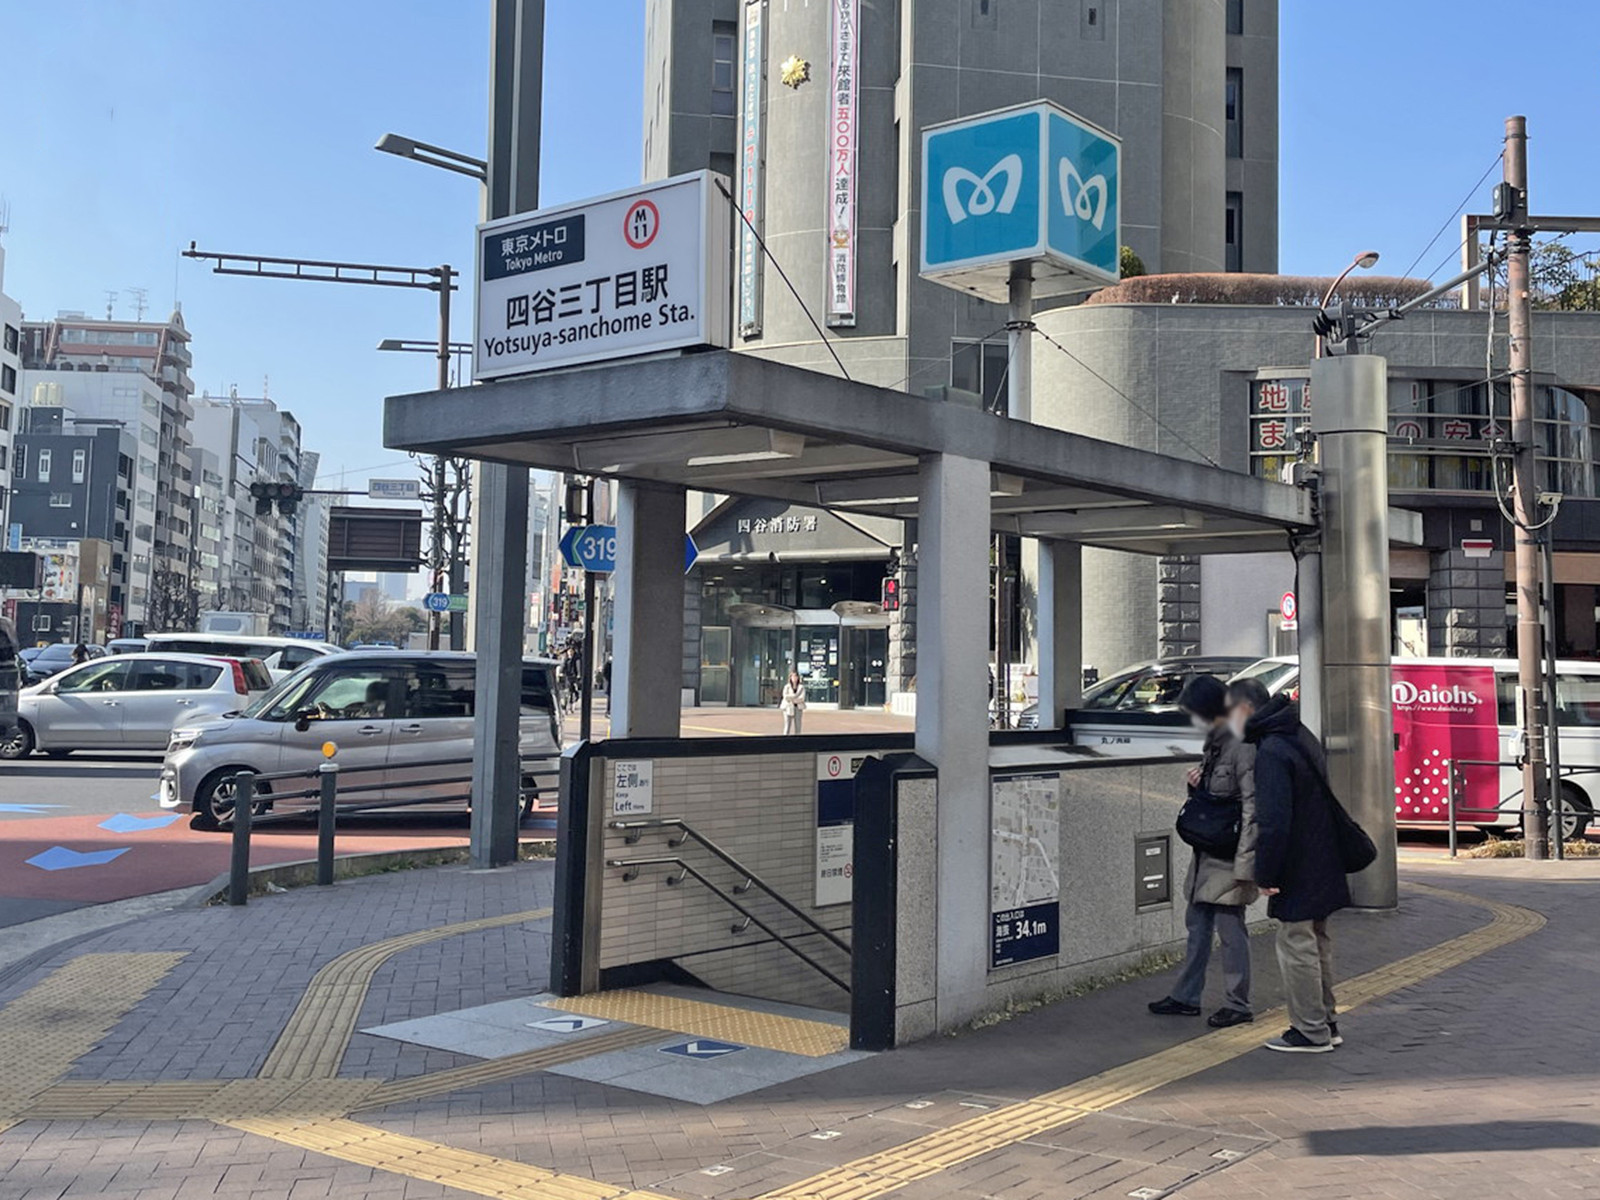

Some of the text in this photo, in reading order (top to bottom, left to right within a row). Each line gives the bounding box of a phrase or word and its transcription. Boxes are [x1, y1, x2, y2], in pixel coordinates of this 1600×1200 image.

[634, 208, 647, 222] M
[501, 225, 567, 257] 東京メトロ
[633, 223, 648, 240] 11
[504, 250, 563, 272] Tokyo Metro
[506, 263, 669, 331] 四谷三丁目駅
[484, 303, 695, 359] Yotsuya-sanchome Sta.
[737, 516, 819, 534] 四谷消防署
[583, 536, 616, 561] 319
[432, 596, 448, 608] 319
[615, 800, 632, 811] Left
